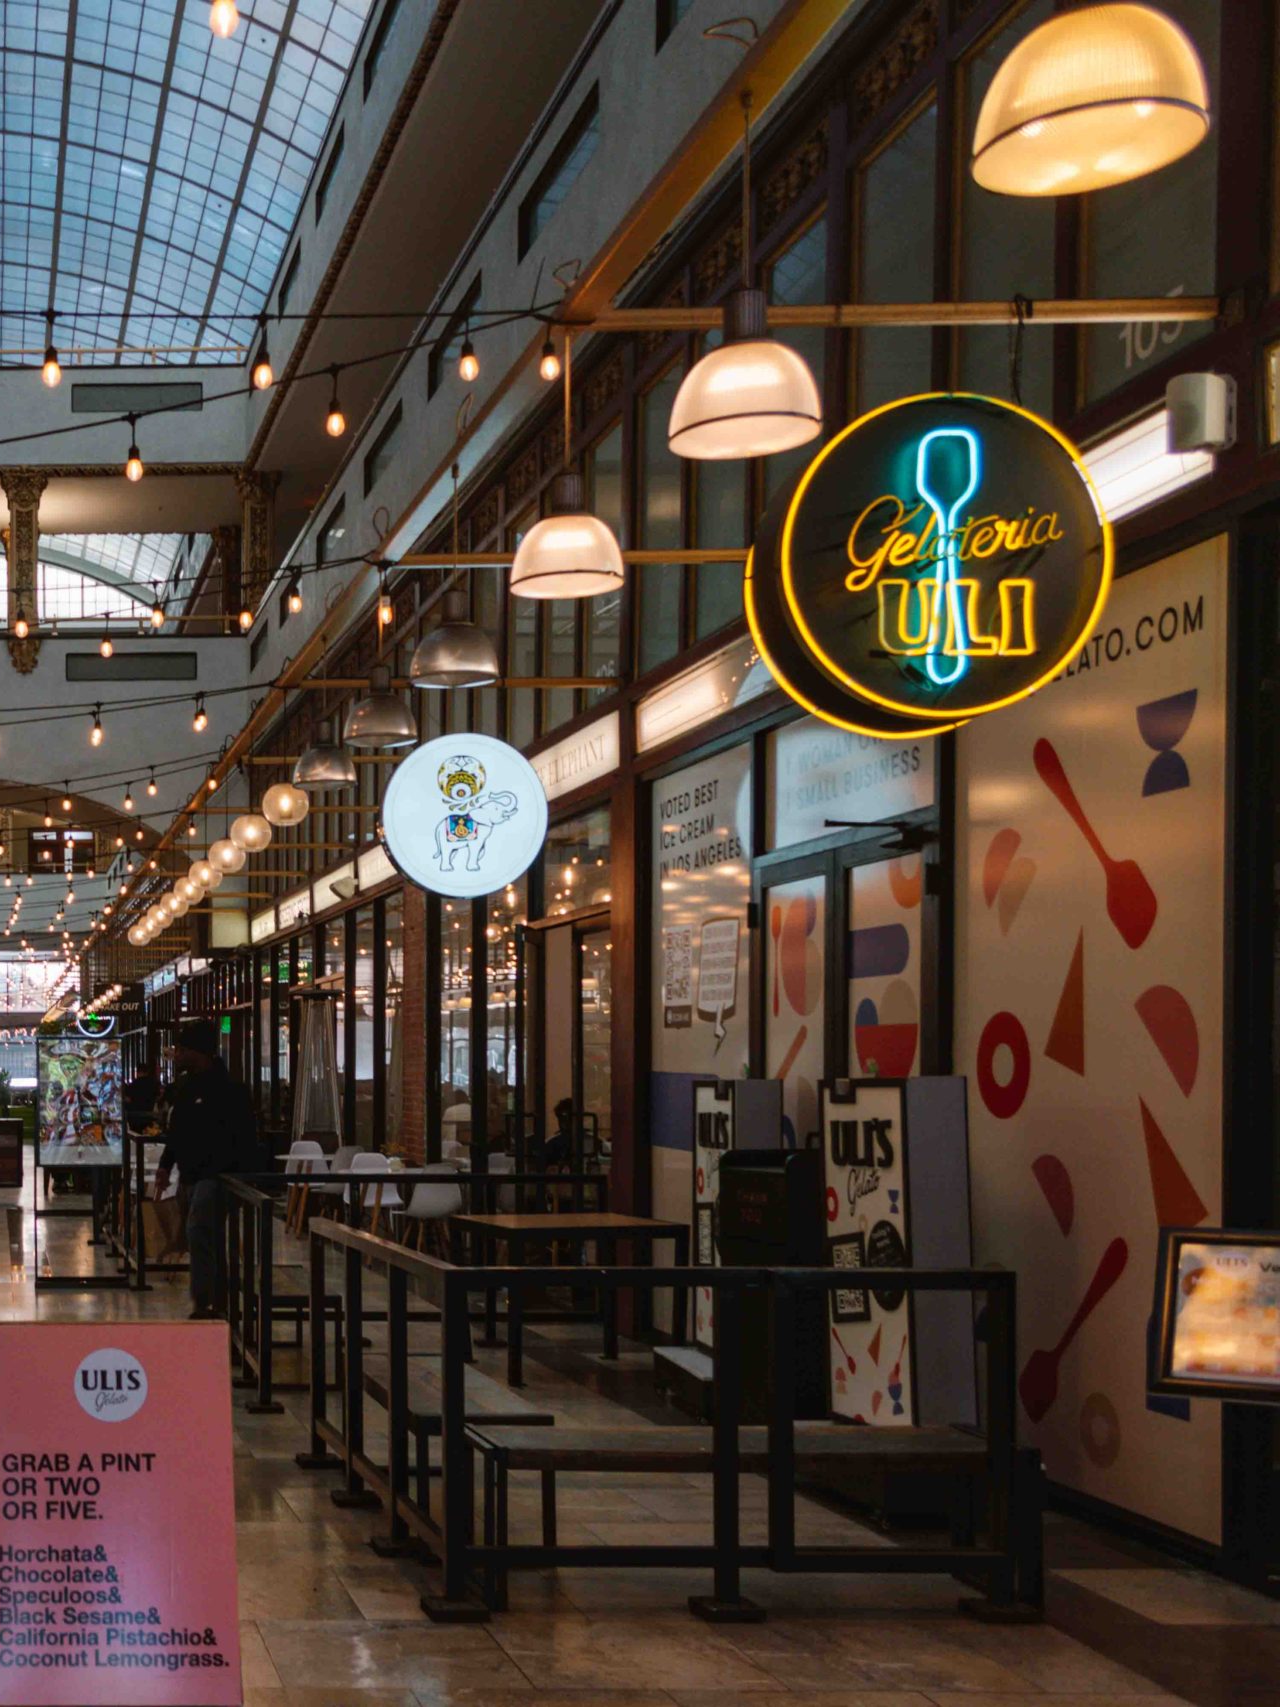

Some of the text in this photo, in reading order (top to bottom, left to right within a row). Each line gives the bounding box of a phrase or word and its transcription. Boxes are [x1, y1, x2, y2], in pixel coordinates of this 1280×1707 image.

[845, 495, 1064, 592] Gelateria
[877, 578, 1037, 656] ULI
[844, 745, 921, 796] BUSINESS
[660, 779, 719, 820] VOTED BEST
[660, 813, 714, 851] ICE CREAM
[660, 861, 670, 881] IN
[693, 835, 742, 871] ANGELES
[121, 1002, 140, 1012] OUT
[829, 1117, 894, 1168] ULI'S
[846, 1168, 881, 1218] Gelato
[81, 1368, 141, 1392] ULI'S
[2, 1453, 156, 1473] GRAB A PINT
[2, 1477, 100, 1496] OR TWO
[2, 1501, 103, 1520] OR FIVE.
[63, 1608, 161, 1625] Sesame&
[105, 1629, 217, 1647] Pistachio&
[95, 1650, 230, 1671] Lemongrass.
